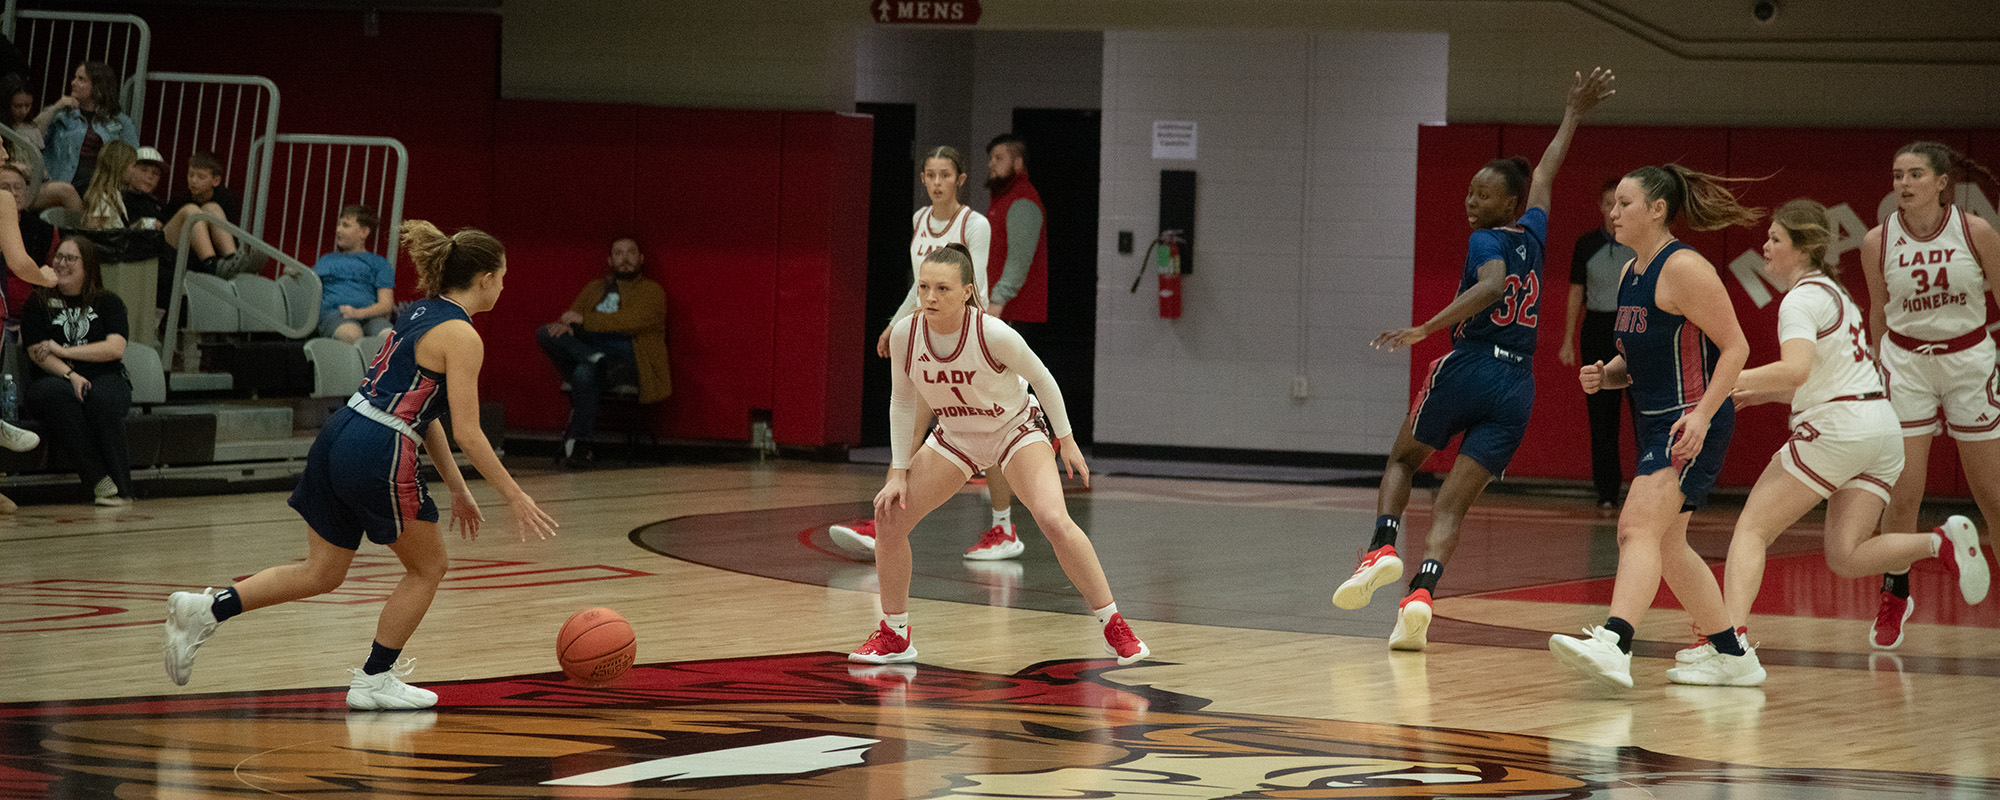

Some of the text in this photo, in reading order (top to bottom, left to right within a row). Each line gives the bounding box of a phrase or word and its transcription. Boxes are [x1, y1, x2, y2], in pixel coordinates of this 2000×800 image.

[898, 2, 963, 19] MENS
[1898, 248, 1956, 268] LADY
[1911, 266, 1950, 295] 34
[1490, 269, 1540, 328] 32
[922, 369, 977, 386] LADY
[950, 386, 969, 406] 1
[932, 402, 1006, 419] PIONEERS
